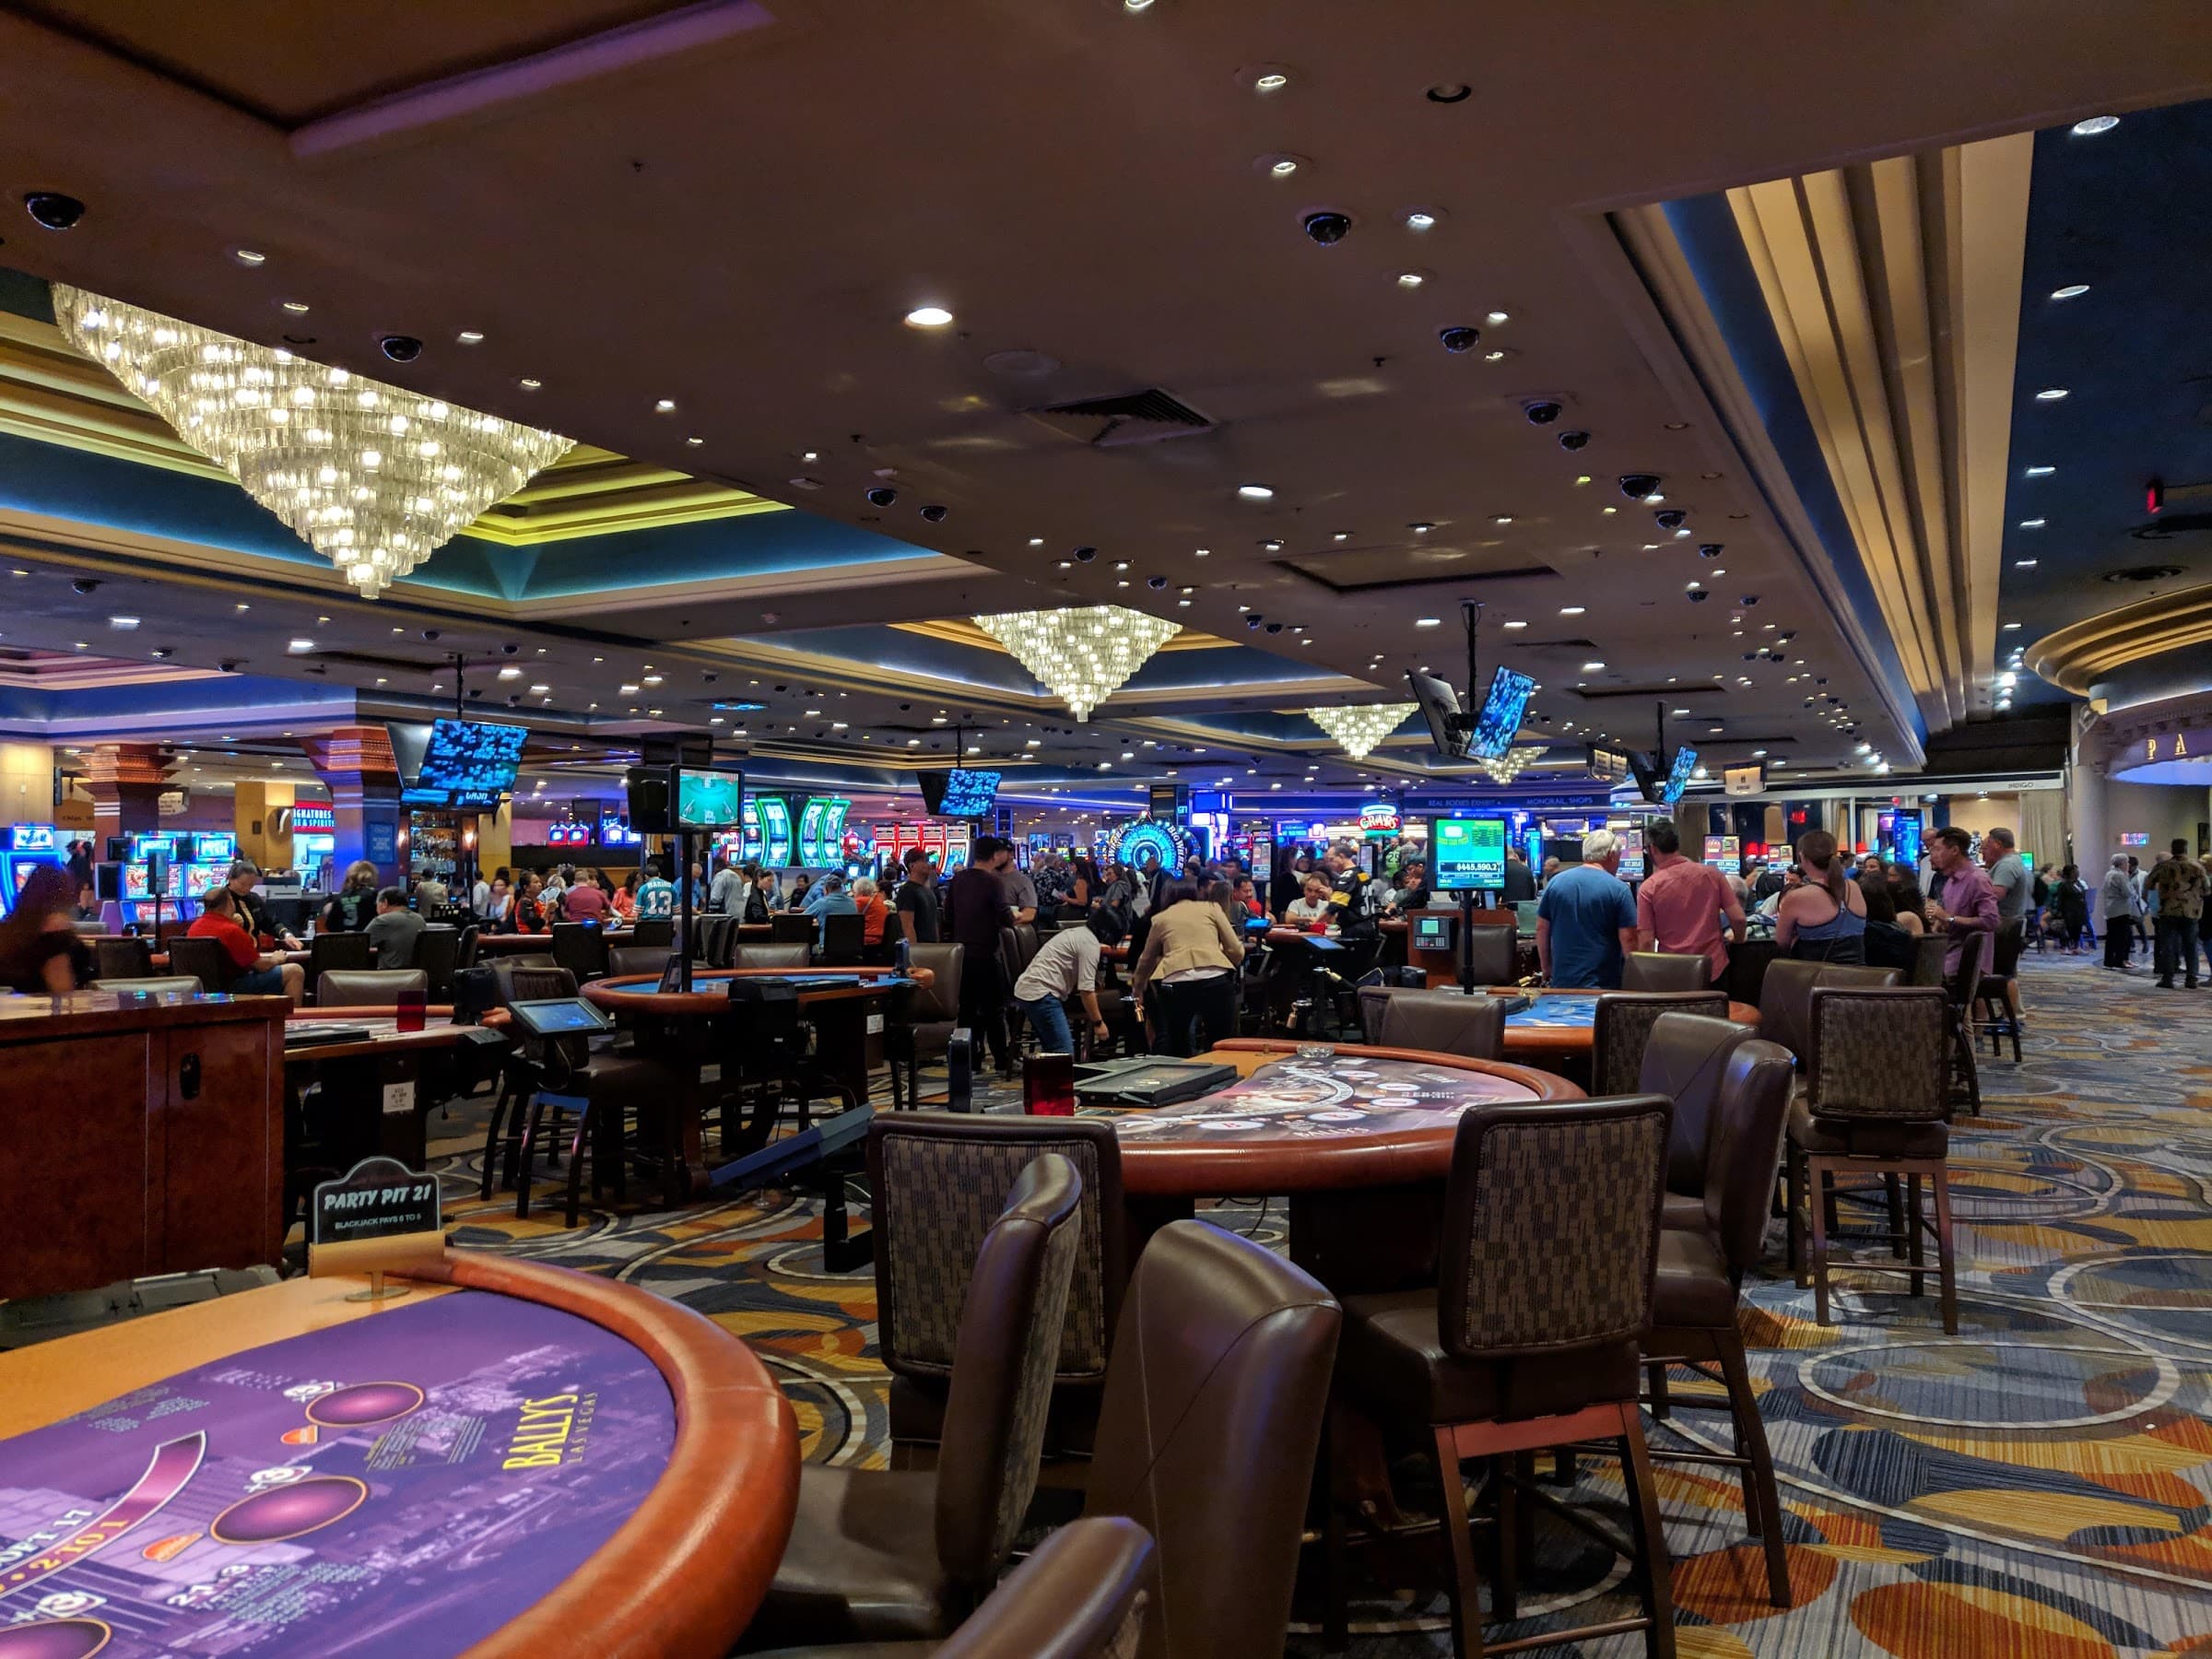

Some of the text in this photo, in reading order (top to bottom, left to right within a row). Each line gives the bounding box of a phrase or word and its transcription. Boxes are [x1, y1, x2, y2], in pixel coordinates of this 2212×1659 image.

[294, 808, 332, 818] IGNATURES
[1359, 815, 1399, 830] CRAPS
[1167, 825, 1180, 841] BIG
[647, 890, 673, 915] 13
[324, 1183, 432, 1210] PARTY PIT 21
[335, 1218, 379, 1230] BLACKJACK
[379, 1215, 398, 1225] PAYS
[406, 1213, 416, 1222] TO
[502, 1394, 579, 1469] BALLY'S
[567, 1392, 598, 1464] LAS VEGAS
[53, 1509, 93, 1526] 17
[29, 1558, 63, 1571] 2
